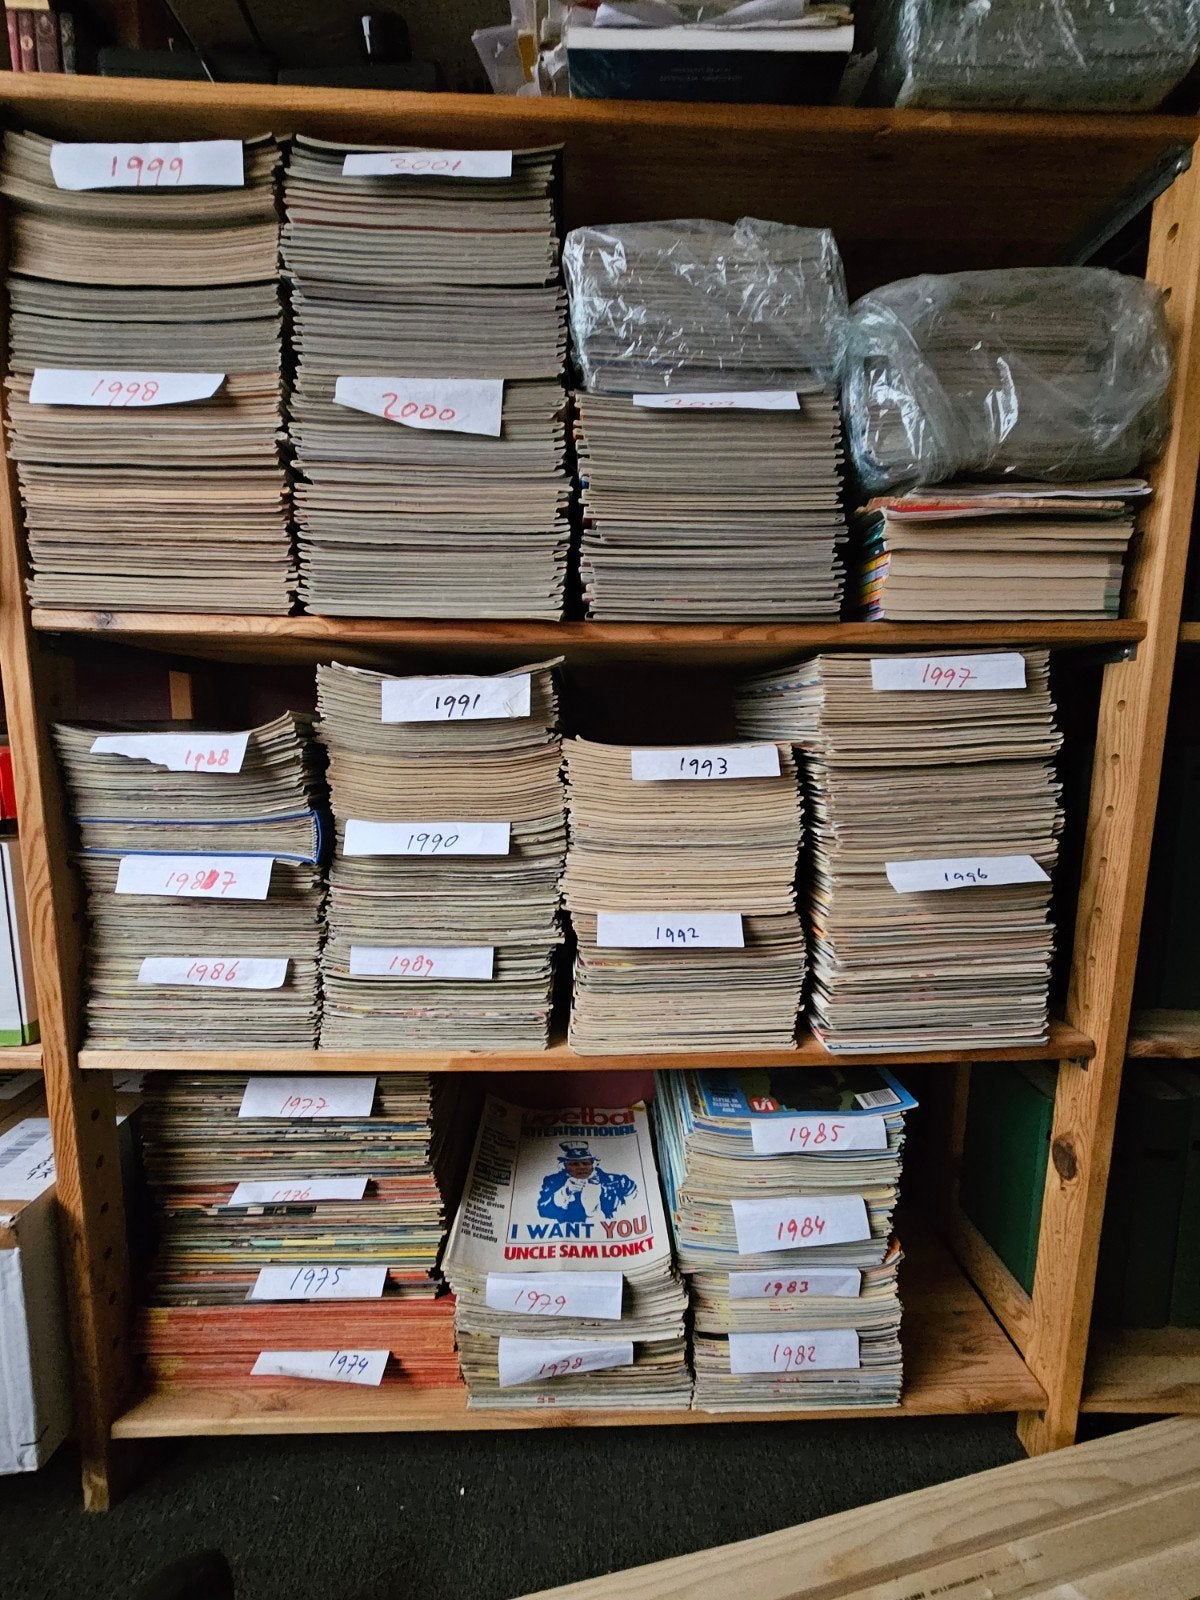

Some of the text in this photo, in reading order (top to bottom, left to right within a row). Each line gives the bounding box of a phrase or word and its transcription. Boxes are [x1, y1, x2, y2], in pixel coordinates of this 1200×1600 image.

[111, 156, 184, 186] 1999
[390, 157, 462, 170] 2001
[91, 379, 159, 406] 1998
[382, 392, 455, 421] 2000
[922, 663, 977, 688] 1997
[435, 694, 481, 718] 1991
[680, 757, 728, 777] 1993
[407, 833, 459, 852] 1990
[944, 867, 988, 882] 1996
[656, 926, 700, 943] 1992
[187, 961, 240, 982] 1986
[389, 955, 434, 976] 1989
[280, 1095, 329, 1118] 1977
[789, 1123, 845, 1147] 1985
[510, 1214, 648, 1240] I WANT YOU
[777, 1215, 826, 1242] 1984
[504, 1236, 655, 1261] UNCLE SAM LONKT
[289, 1266, 350, 1294] 1975
[764, 1281, 809, 1296] 1983
[514, 1290, 567, 1315] 1979
[328, 1350, 369, 1376] 1974
[539, 1357, 583, 1376] 1978
[773, 1344, 817, 1372] 1982
